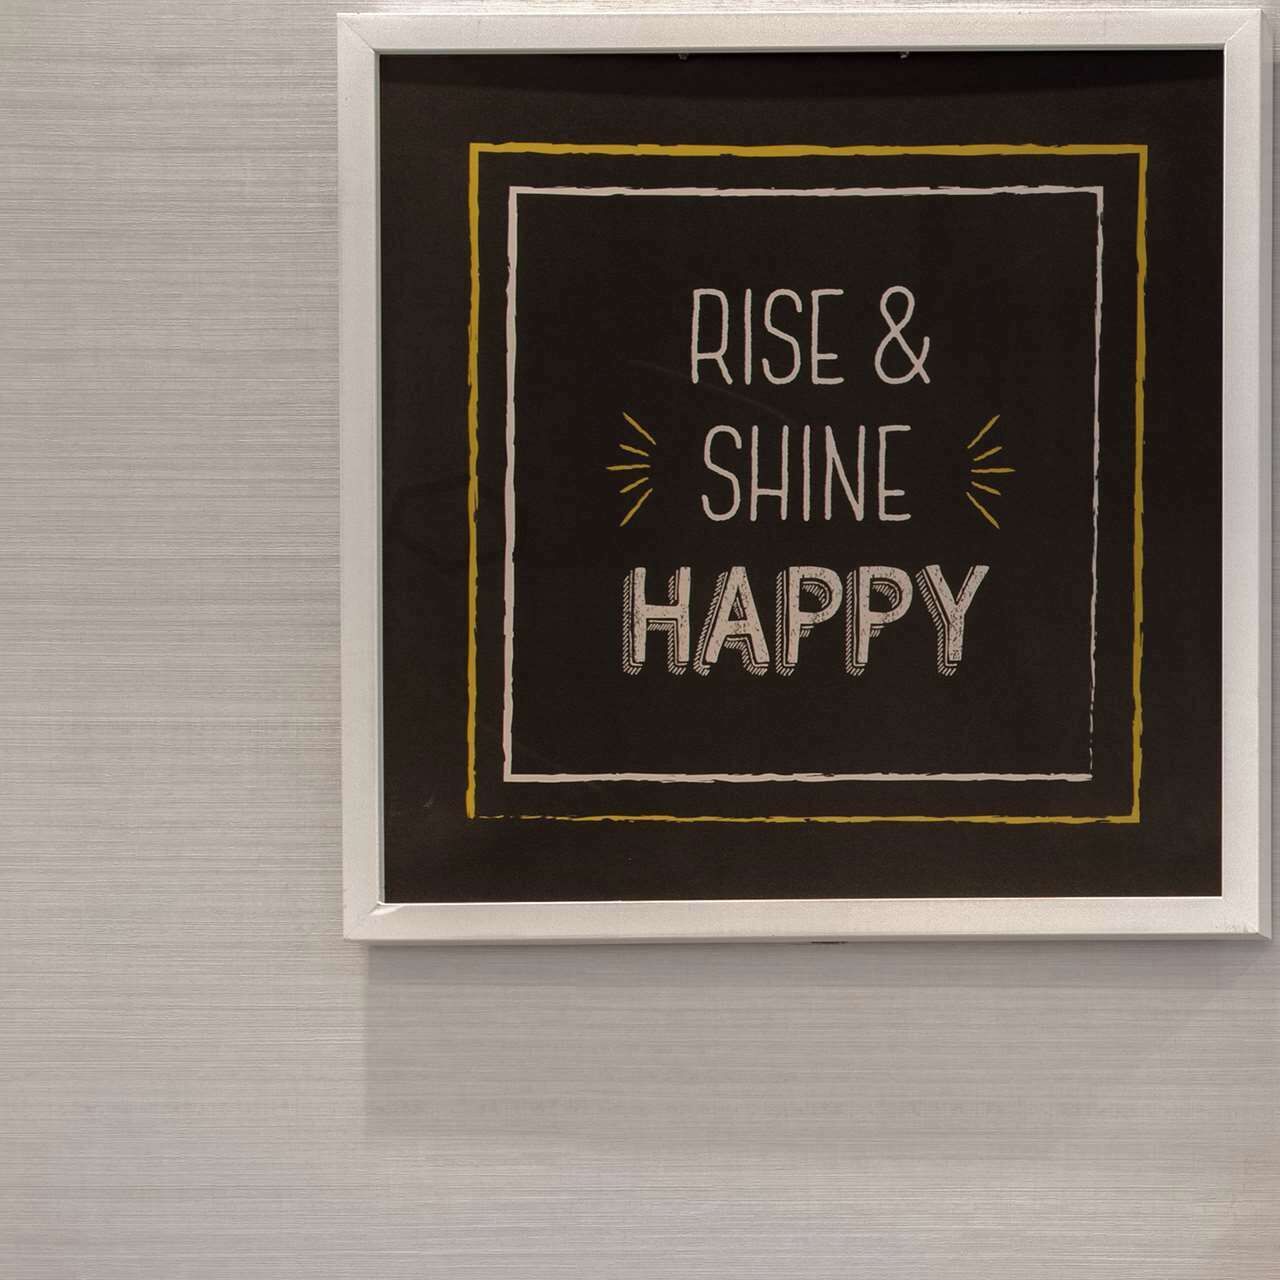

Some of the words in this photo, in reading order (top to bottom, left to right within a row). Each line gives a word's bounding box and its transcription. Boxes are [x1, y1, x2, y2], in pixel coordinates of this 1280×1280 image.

[691, 288, 844, 385] RISE
[874, 285, 931, 385] &
[703, 424, 912, 522] SHINE
[622, 565, 990, 676] HAPPY
